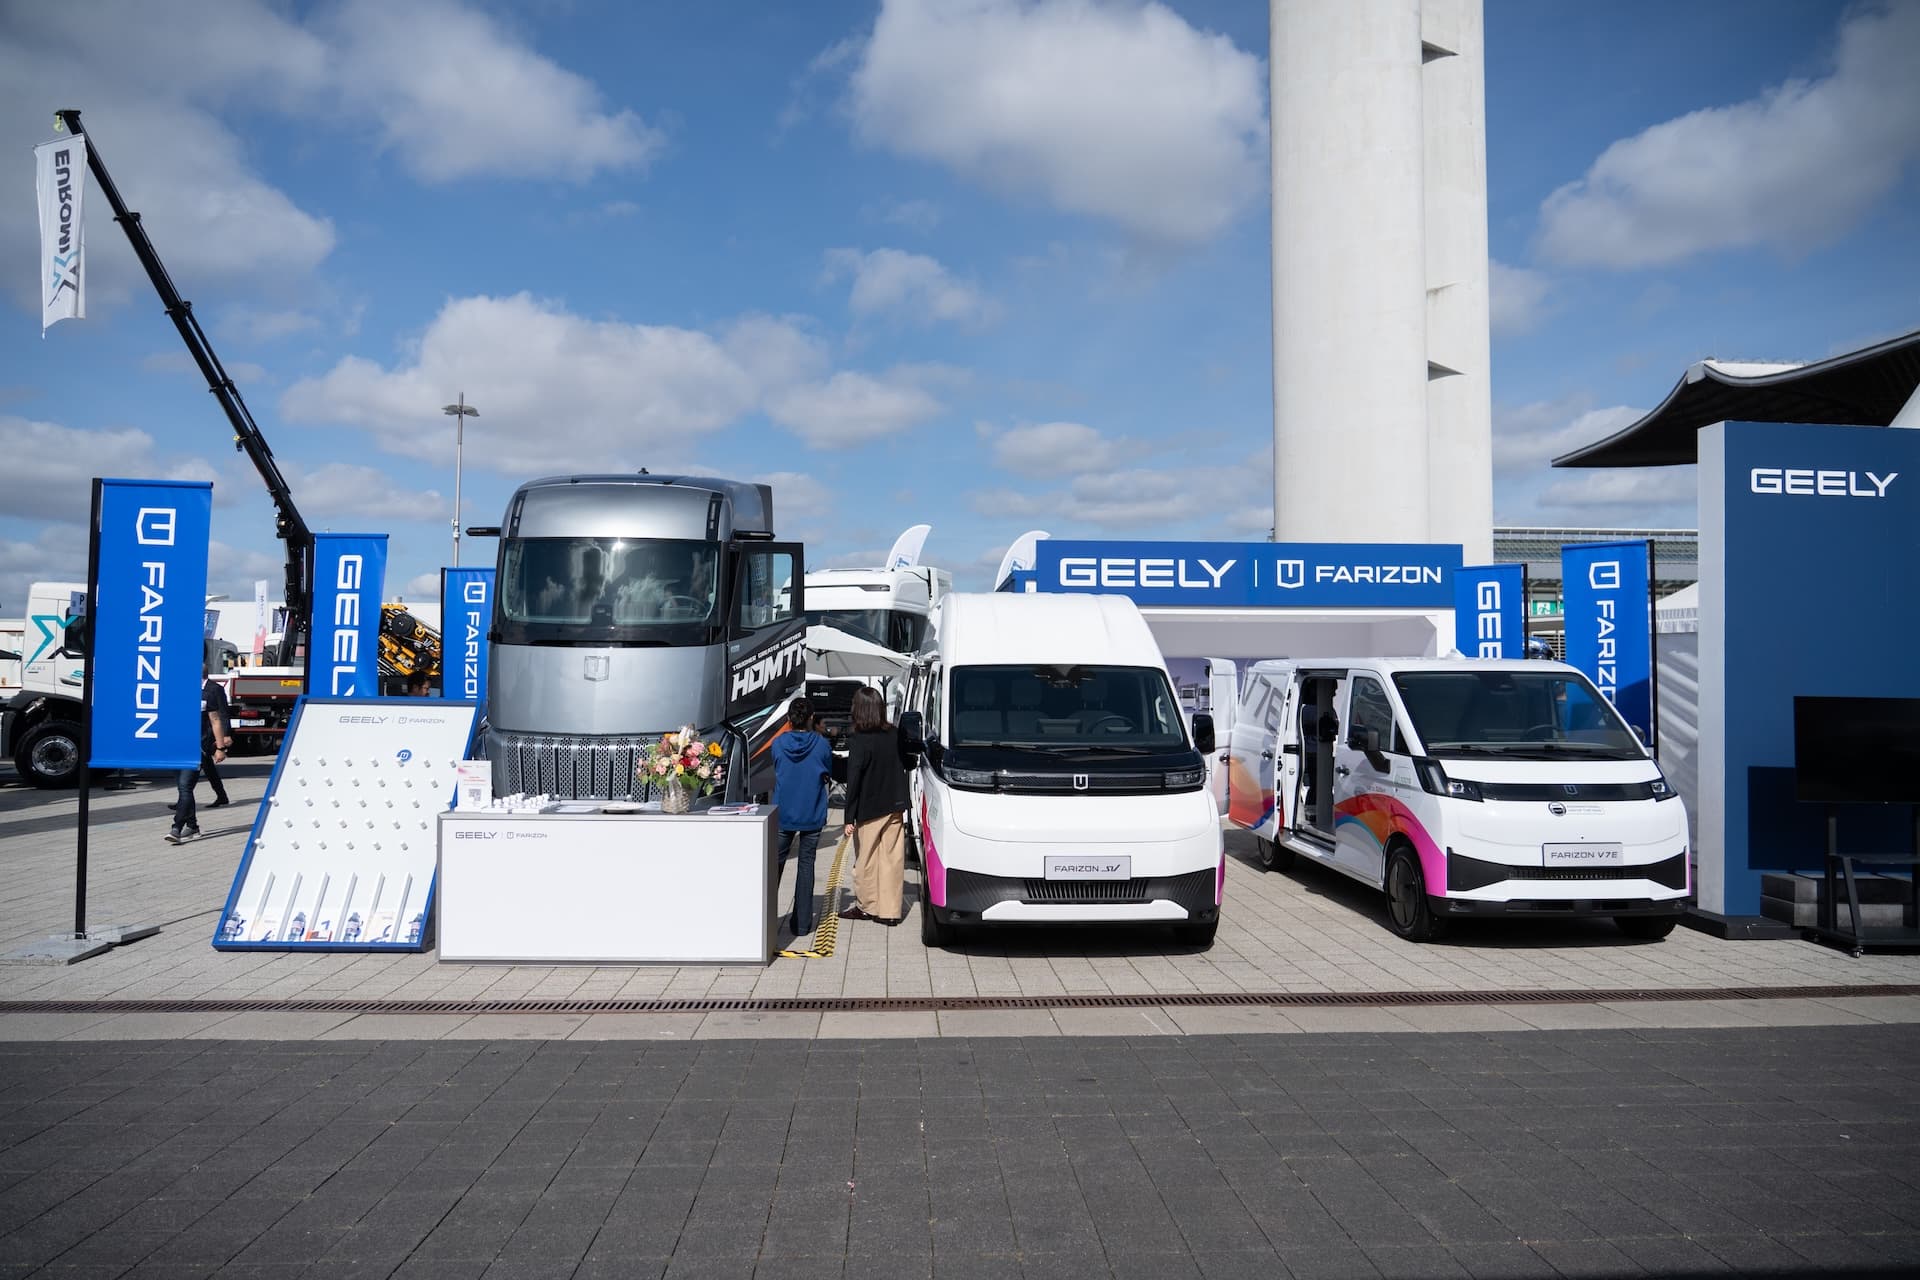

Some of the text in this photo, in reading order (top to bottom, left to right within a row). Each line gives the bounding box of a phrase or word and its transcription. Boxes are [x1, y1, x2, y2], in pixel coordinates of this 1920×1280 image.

[1751, 468, 1897, 498] GEELY
[1059, 557, 1442, 588] GEELY FARIZON
[331, 554, 363, 696] GEEL
[134, 561, 165, 739] FARIZON
[464, 611, 481, 699] FARIZO
[339, 715, 389, 724] GEELY
[455, 831, 498, 840] GEELY
[1054, 865, 1099, 873] FARIZON
[1550, 850, 1618, 860] FARIZON V7E
